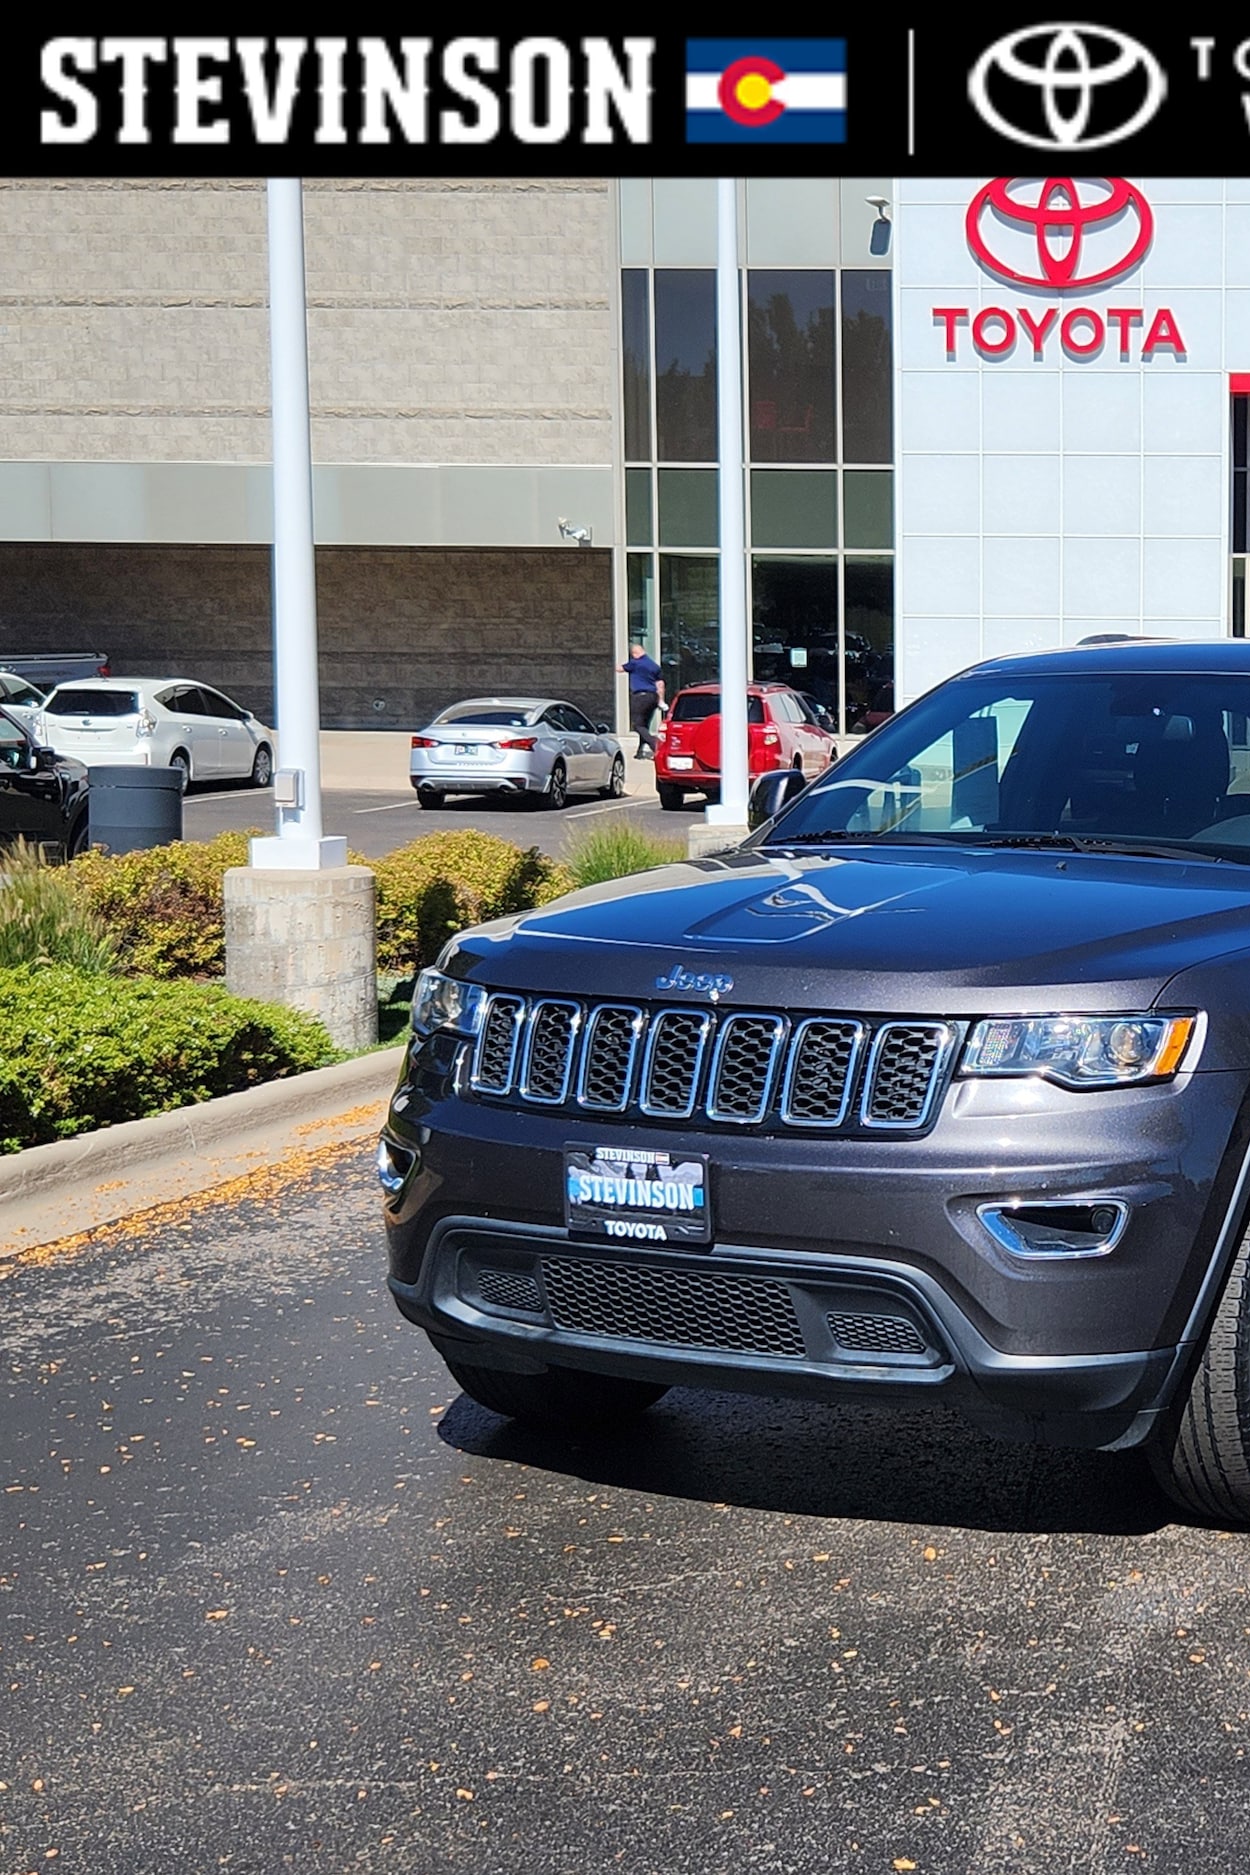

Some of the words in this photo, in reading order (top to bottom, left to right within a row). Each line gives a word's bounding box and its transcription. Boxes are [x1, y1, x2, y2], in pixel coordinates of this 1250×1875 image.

[932, 306, 1187, 358] TOYOTA
[655, 965, 735, 1000] Jeep
[595, 1147, 656, 1165] STEVINSON
[579, 1174, 695, 1210] STEVINSON
[604, 1220, 667, 1241] TOYOTA
